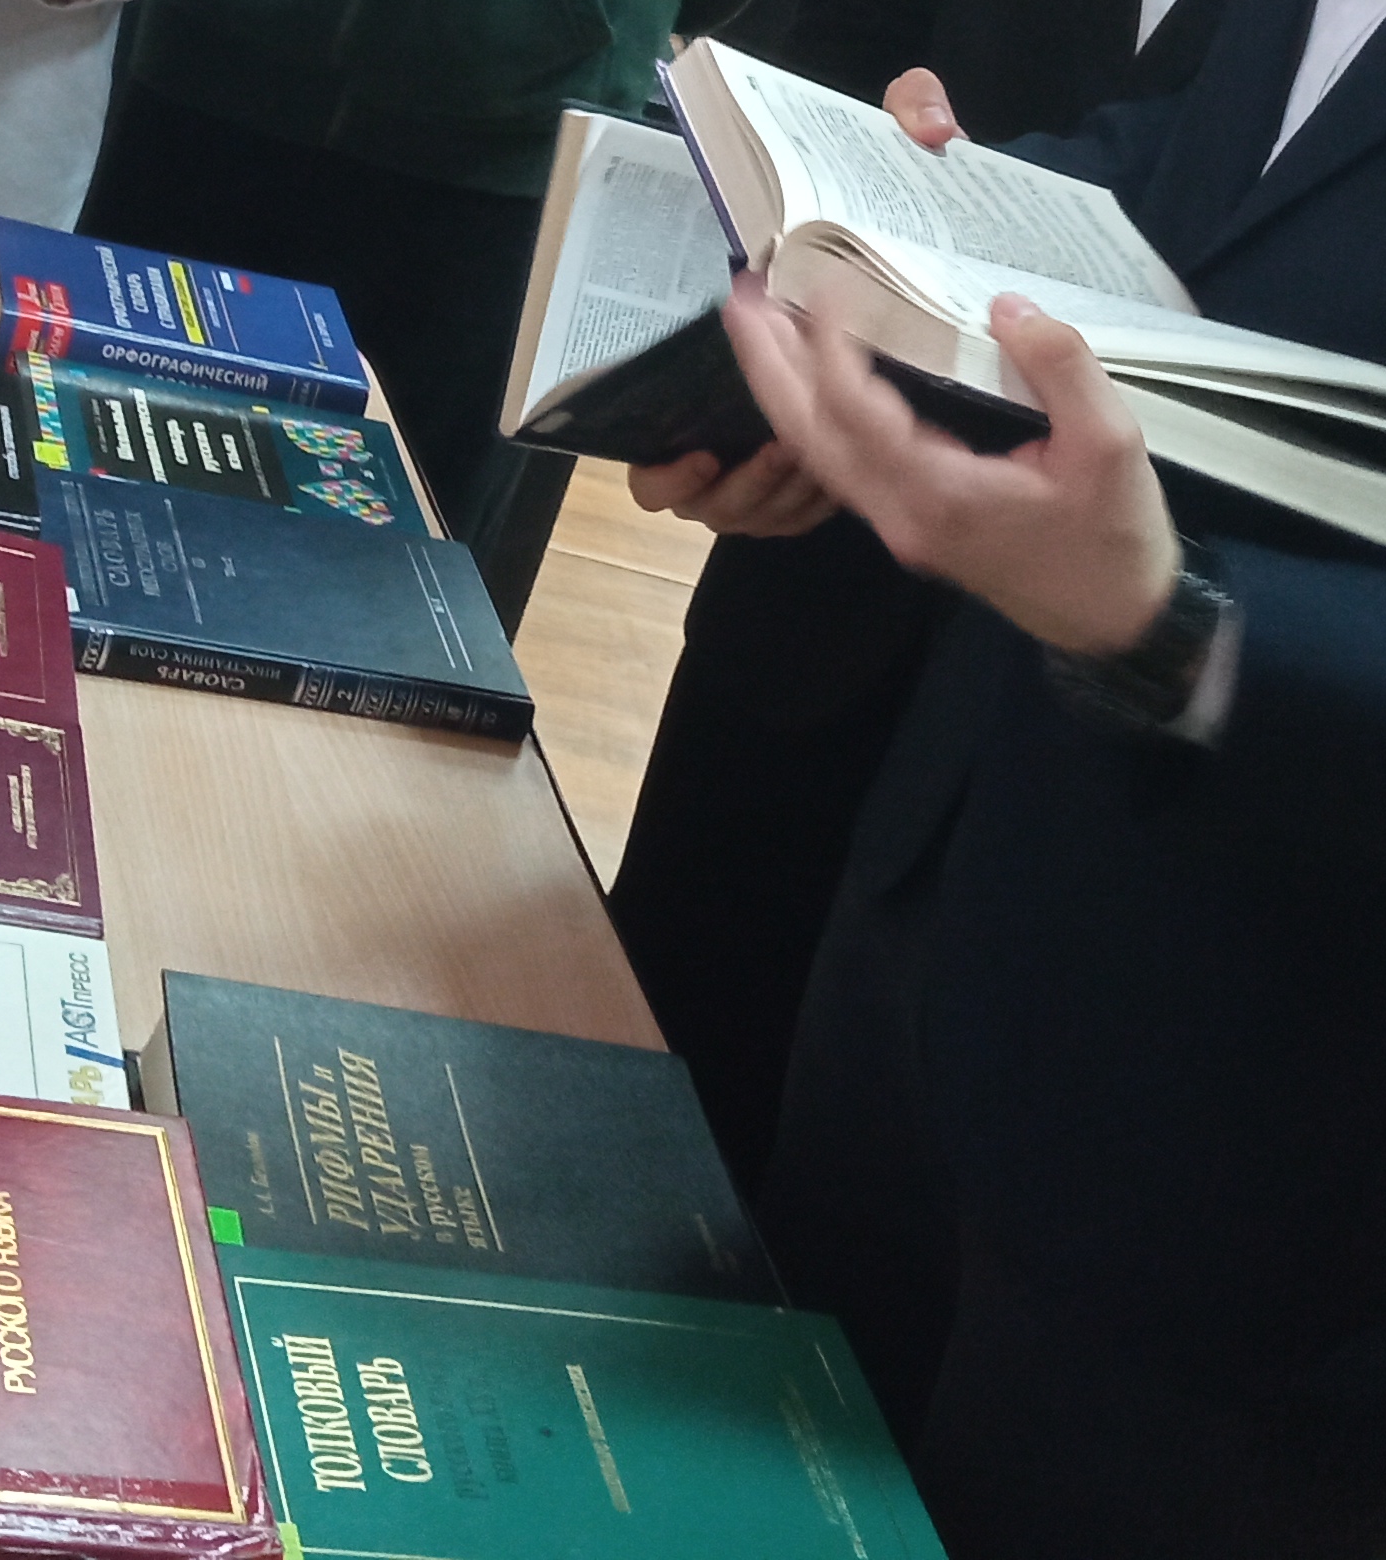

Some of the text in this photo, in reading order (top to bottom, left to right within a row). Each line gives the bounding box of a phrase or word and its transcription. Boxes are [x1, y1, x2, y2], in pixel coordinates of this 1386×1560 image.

[103, 344, 270, 391] ОРФОГРАФИЧЕСКИЙ
[93, 508, 130, 588] СЛОВАРЬ
[156, 666, 246, 692] СЛОВАРЬ
[299, 1063, 369, 1230] РИФМЫ и
[337, 1047, 422, 1239] УДАРЕНИЯ
[410, 1144, 457, 1227] русском
[270, 1333, 367, 1492] ТОЛКОВЫЙ
[357, 1357, 433, 1483] СЛОВАРЬ
